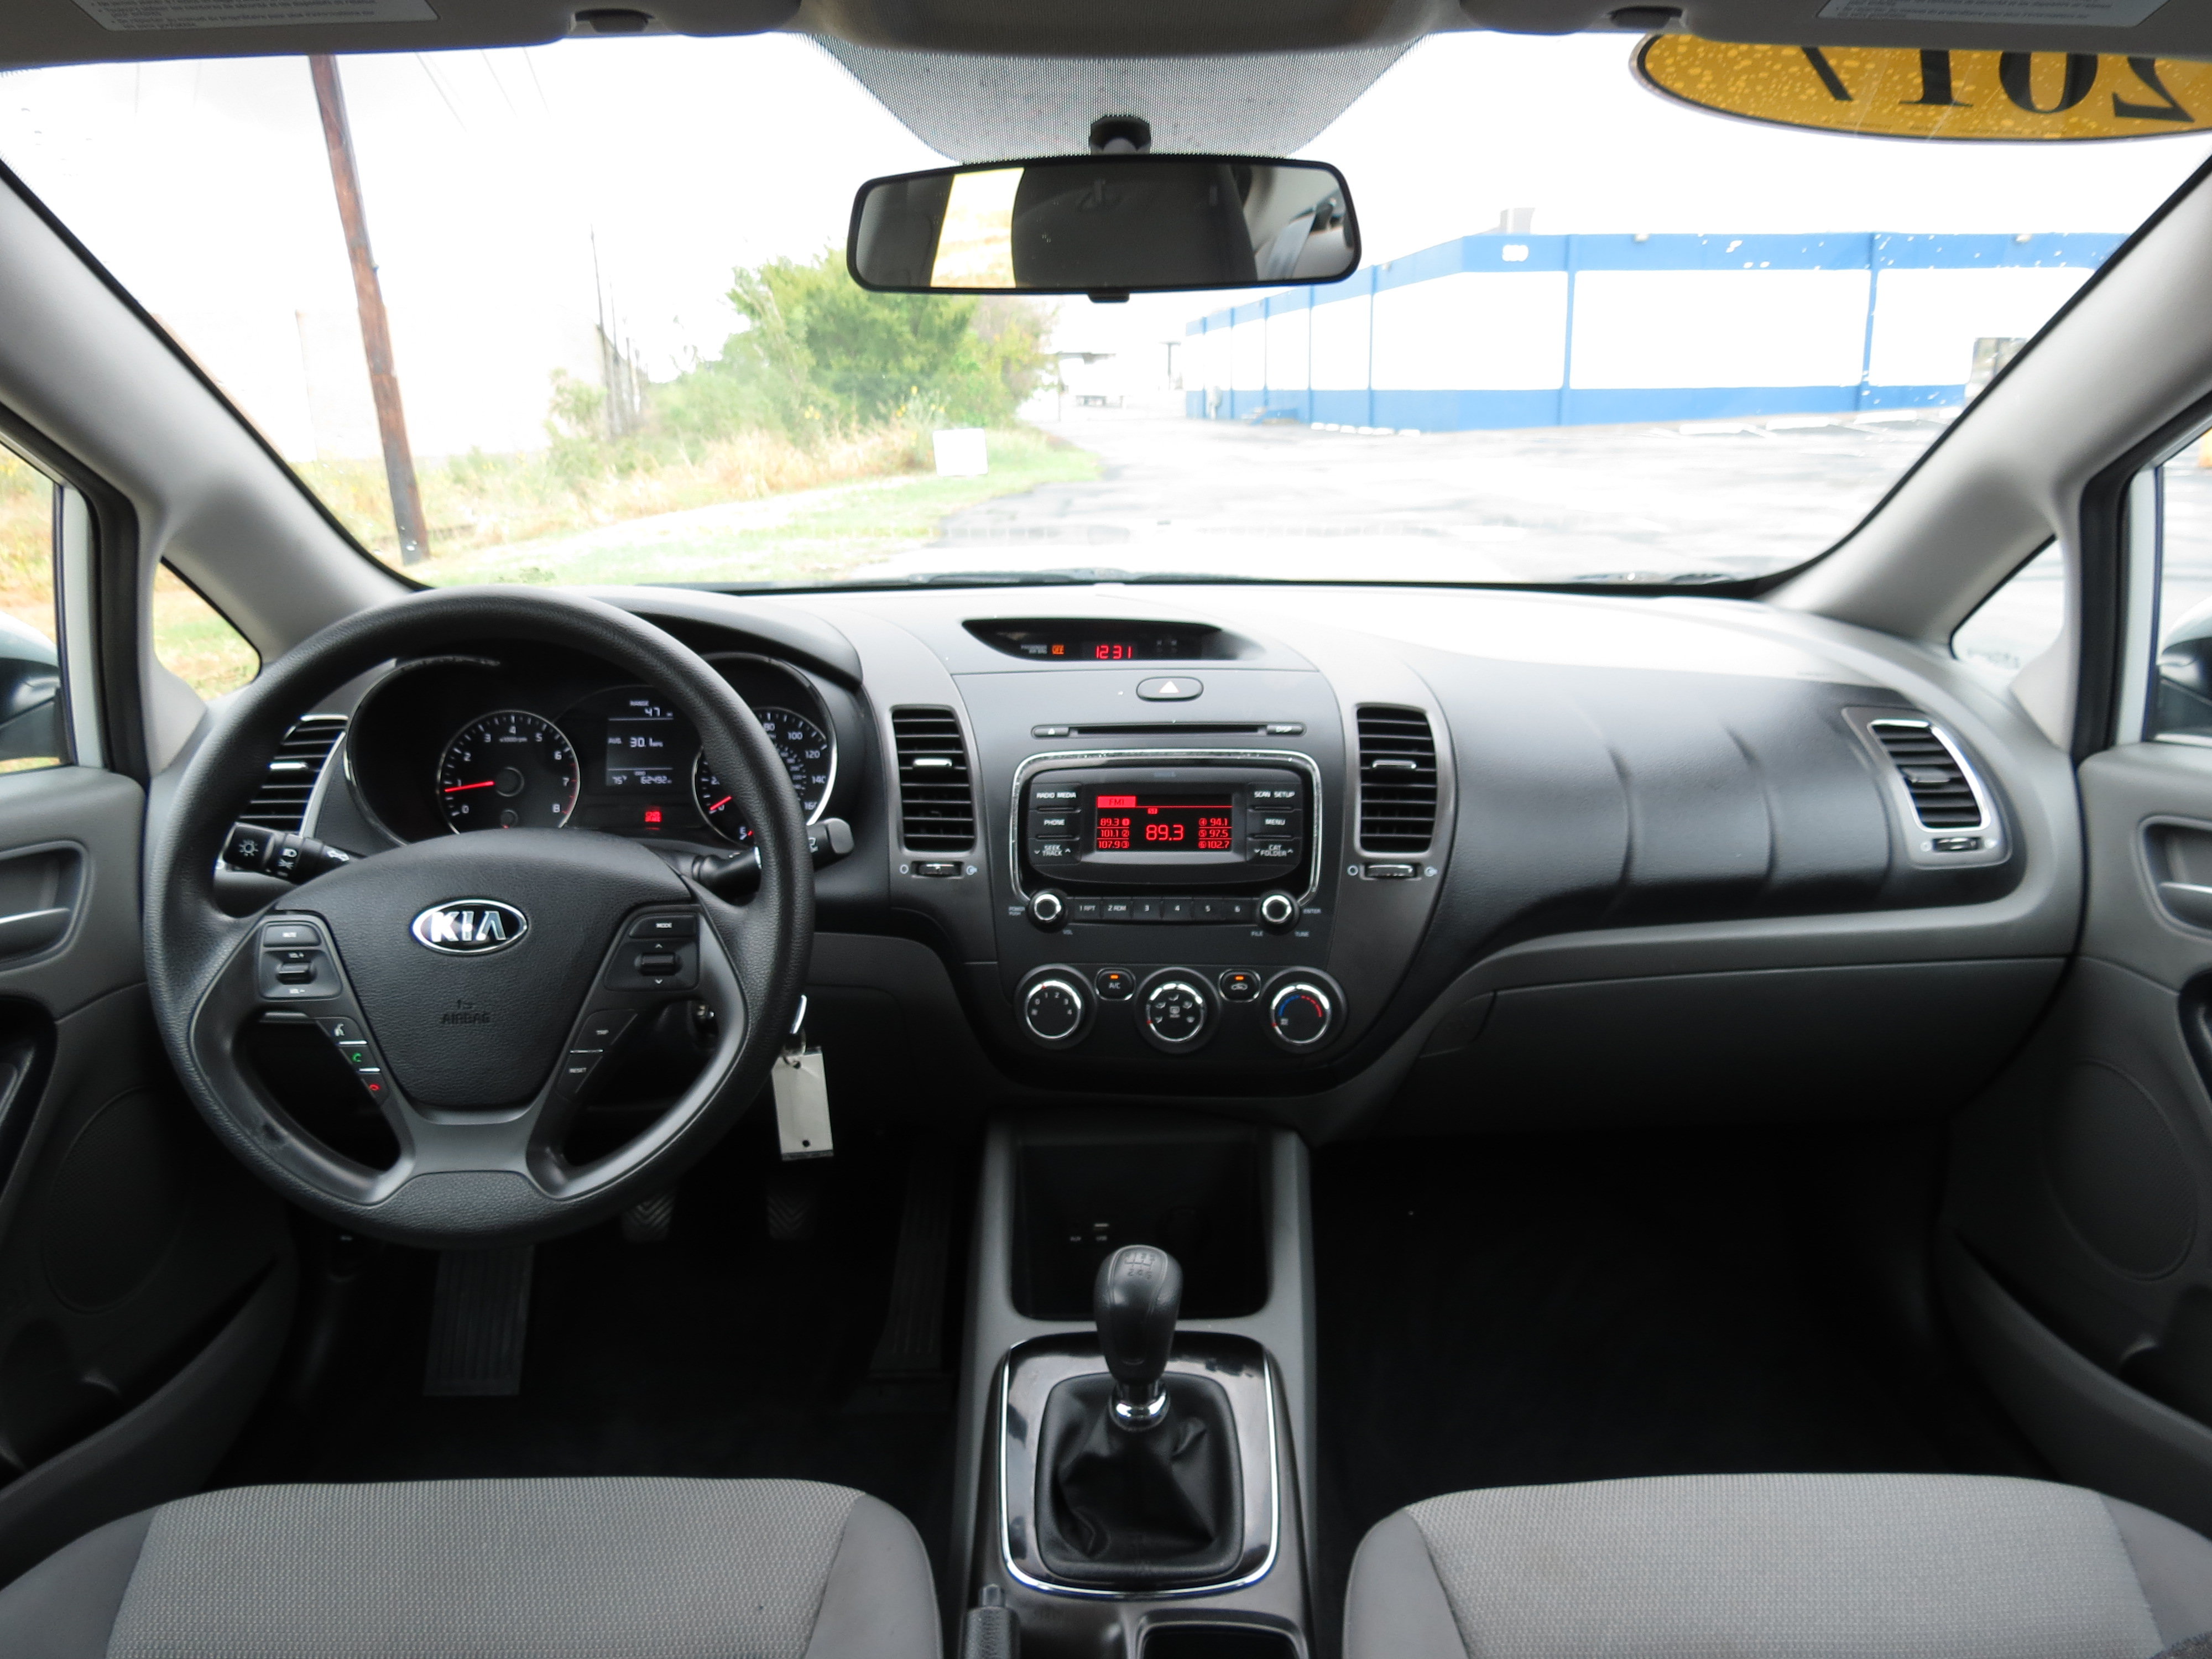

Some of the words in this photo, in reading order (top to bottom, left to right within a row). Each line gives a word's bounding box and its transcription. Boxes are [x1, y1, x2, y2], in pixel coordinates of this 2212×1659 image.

[644, 707, 660, 717] 47
[509, 726, 516, 734] 4
[484, 733, 491, 742] 3
[535, 732, 542, 742] 5
[787, 732, 803, 740] 100
[463, 752, 471, 761] 2
[554, 751, 562, 760] 6
[805, 750, 821, 759] 120
[562, 776, 570, 786] 7
[461, 805, 469, 813] 0
[552, 804, 560, 813] 8
[1146, 824, 1184, 841] 89.3
[1209, 830, 1228, 838] 97.5
[1099, 841, 1120, 849] 107.9
[1208, 841, 1229, 849] 102.7
[431, 910, 507, 942] KIA
